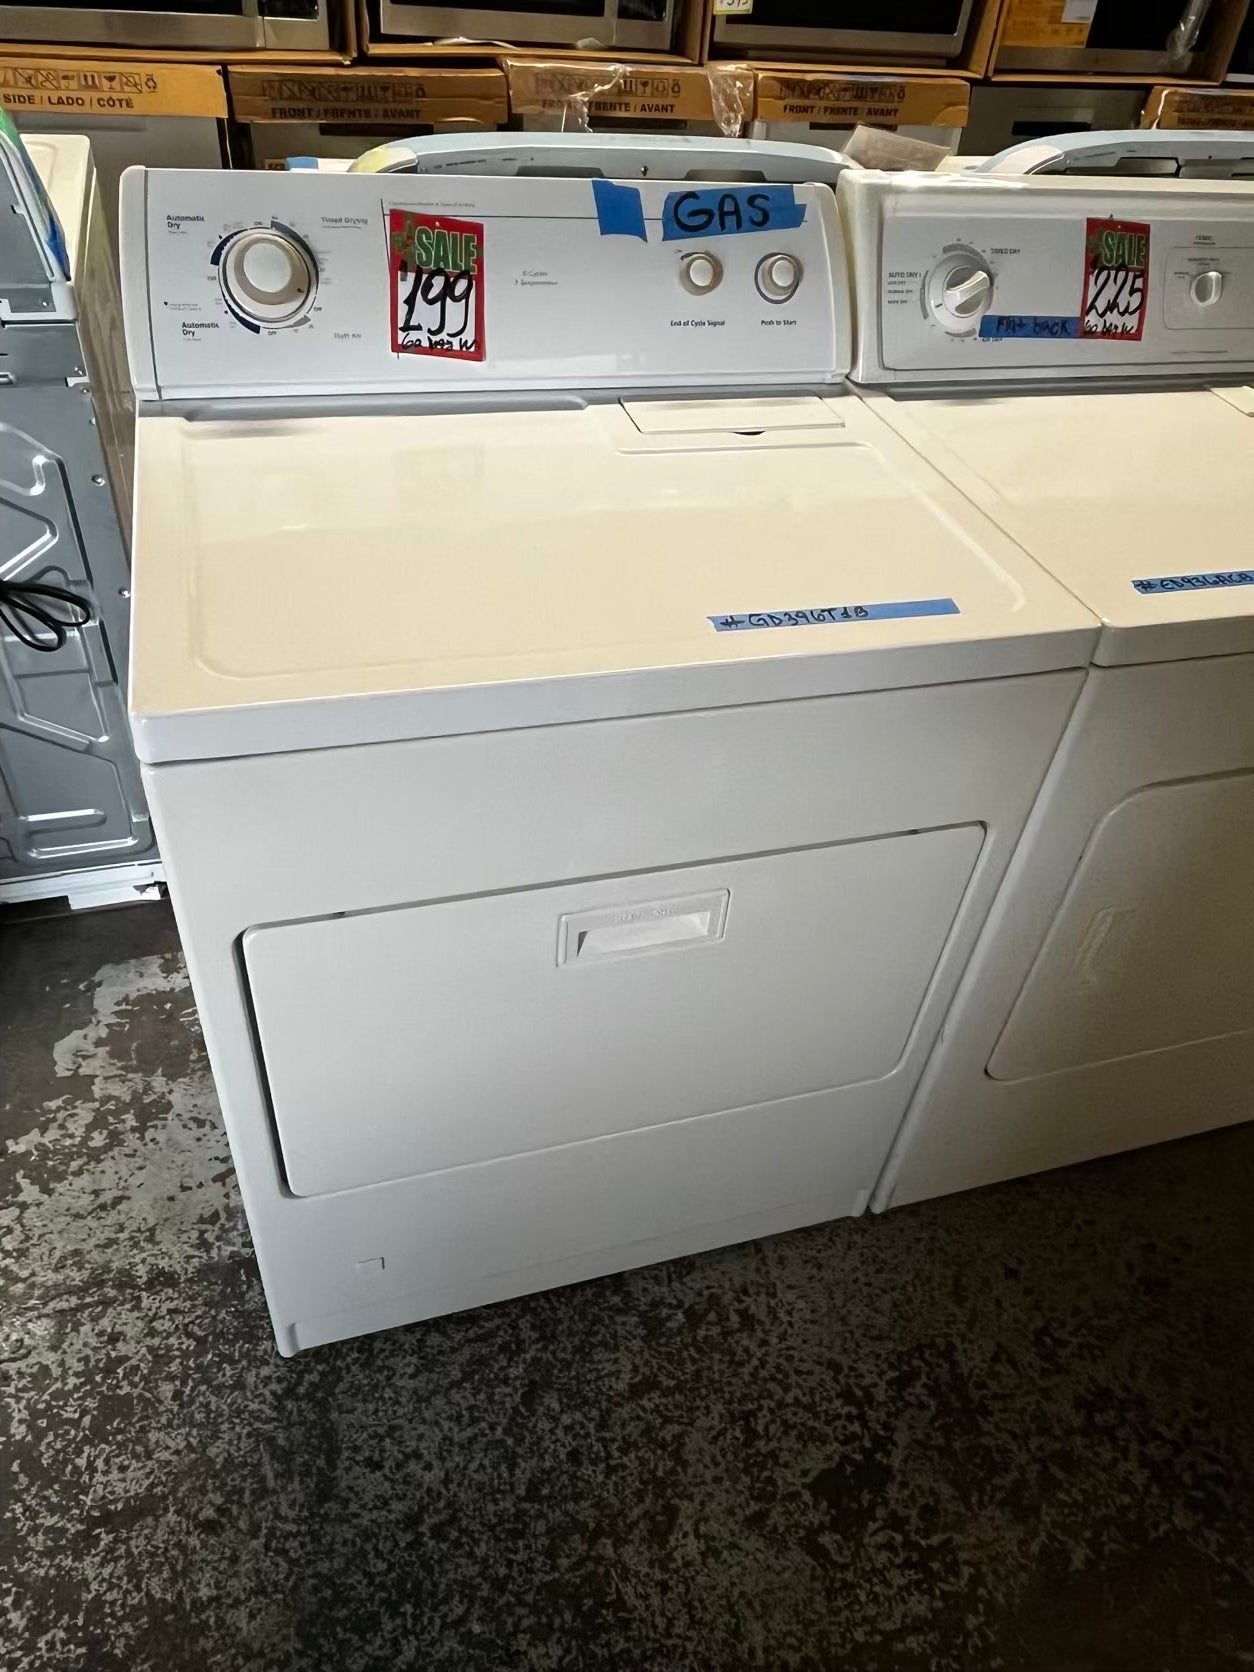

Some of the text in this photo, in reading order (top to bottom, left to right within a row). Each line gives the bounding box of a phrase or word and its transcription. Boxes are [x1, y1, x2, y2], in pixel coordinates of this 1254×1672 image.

[3, 94, 35, 105] SIDE
[48, 96, 85, 106] LADO
[272, 107, 313, 119] FRONT
[324, 108, 371, 119] FRENTE
[382, 109, 422, 119] AVANT
[640, 104, 675, 113] AVANT
[784, 104, 815, 114] FRONT
[824, 106, 858, 116] FRENTE
[866, 107, 899, 117] AVANT
[673, 191, 770, 232] GAS
[166, 214, 205, 222] Automatic
[167, 221, 181, 229] Dry
[415, 226, 478, 275] SALE
[1103, 230, 1146, 269] SALE
[1085, 265, 1145, 318] 225
[690, 319, 706, 328] Cycle
[182, 329, 196, 337] Dry
